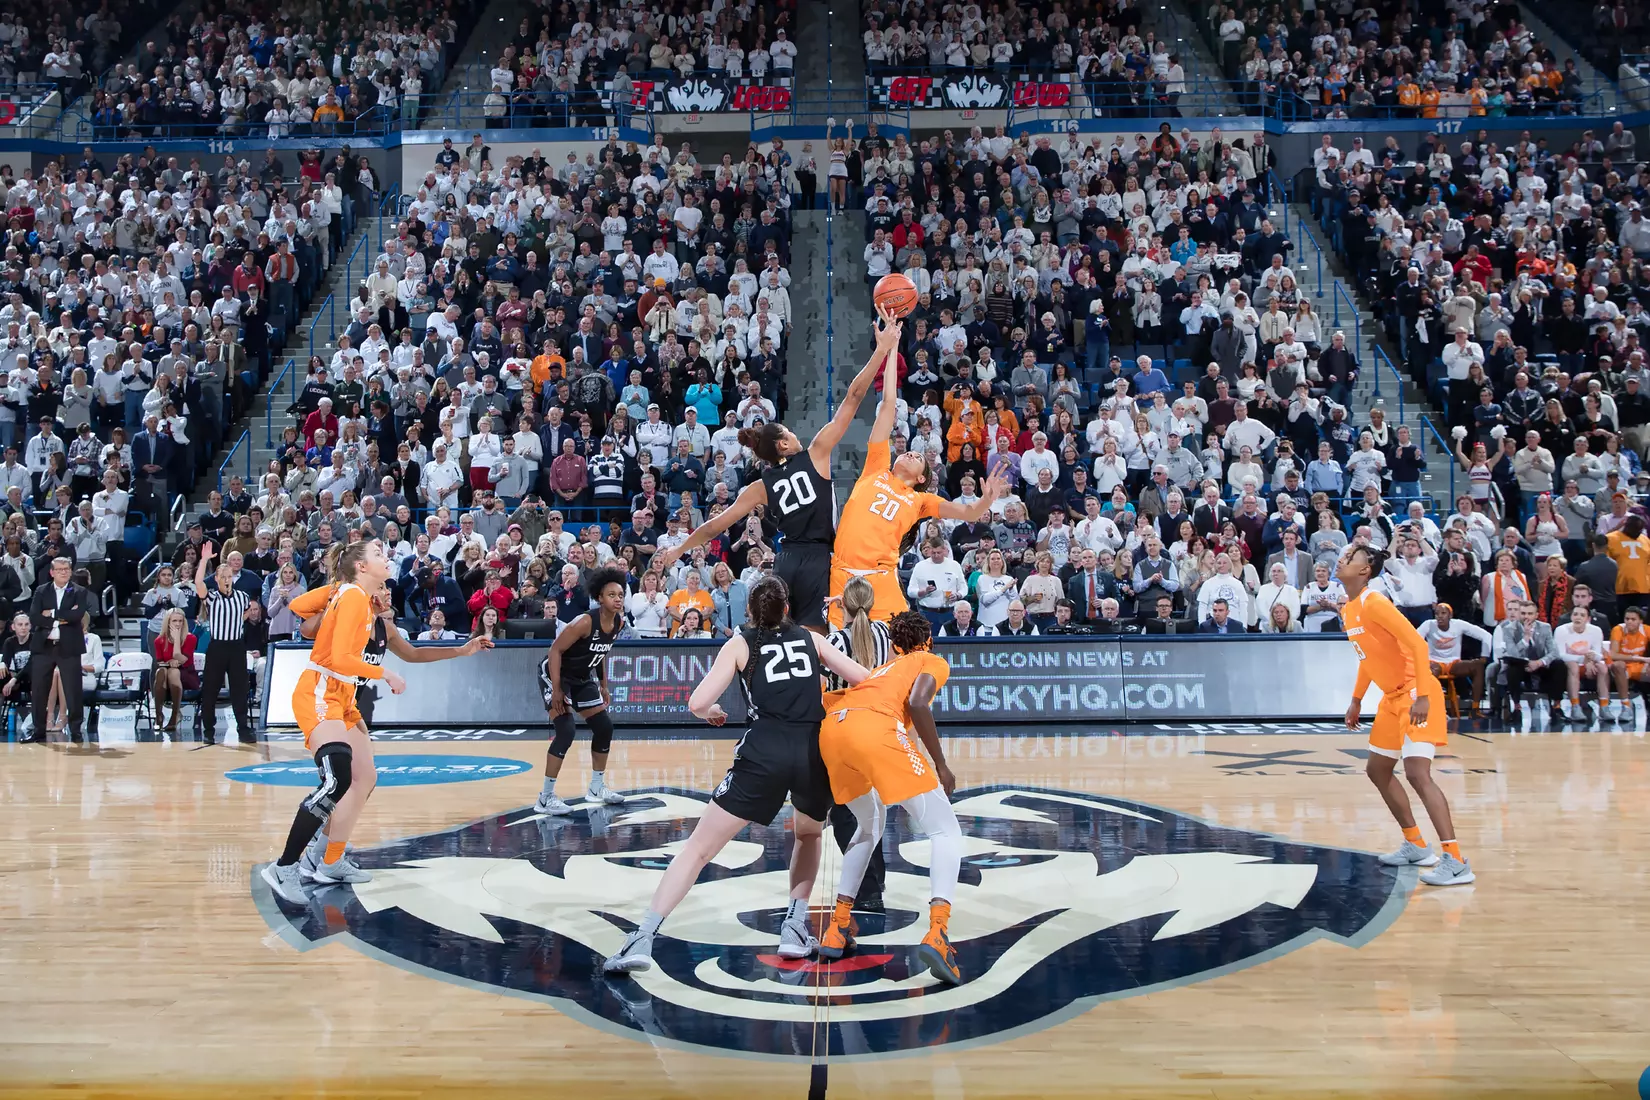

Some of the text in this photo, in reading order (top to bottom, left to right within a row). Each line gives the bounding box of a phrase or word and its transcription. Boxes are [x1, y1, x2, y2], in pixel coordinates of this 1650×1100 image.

[733, 85, 790, 110] LOUD
[889, 76, 1070, 106] GET LOUD
[687, 114, 698, 122] EXIT
[1050, 120, 1079, 132] 116
[1436, 121, 1462, 133] 117
[208, 141, 234, 154] 114
[309, 387, 329, 395] UCONN
[772, 470, 817, 515] 20
[869, 492, 901, 521] 20
[1621, 540, 1642, 559] T
[595, 654, 713, 682] CONN
[760, 640, 812, 683] 25
[979, 650, 1061, 668] UCONN
[1066, 650, 1134, 668] NEWS
[1140, 650, 1169, 667] AT
[929, 682, 1206, 712] HUSKYHQ.COM
[606, 705, 643, 713] PORTS
[102, 715, 133, 724] genius3D
